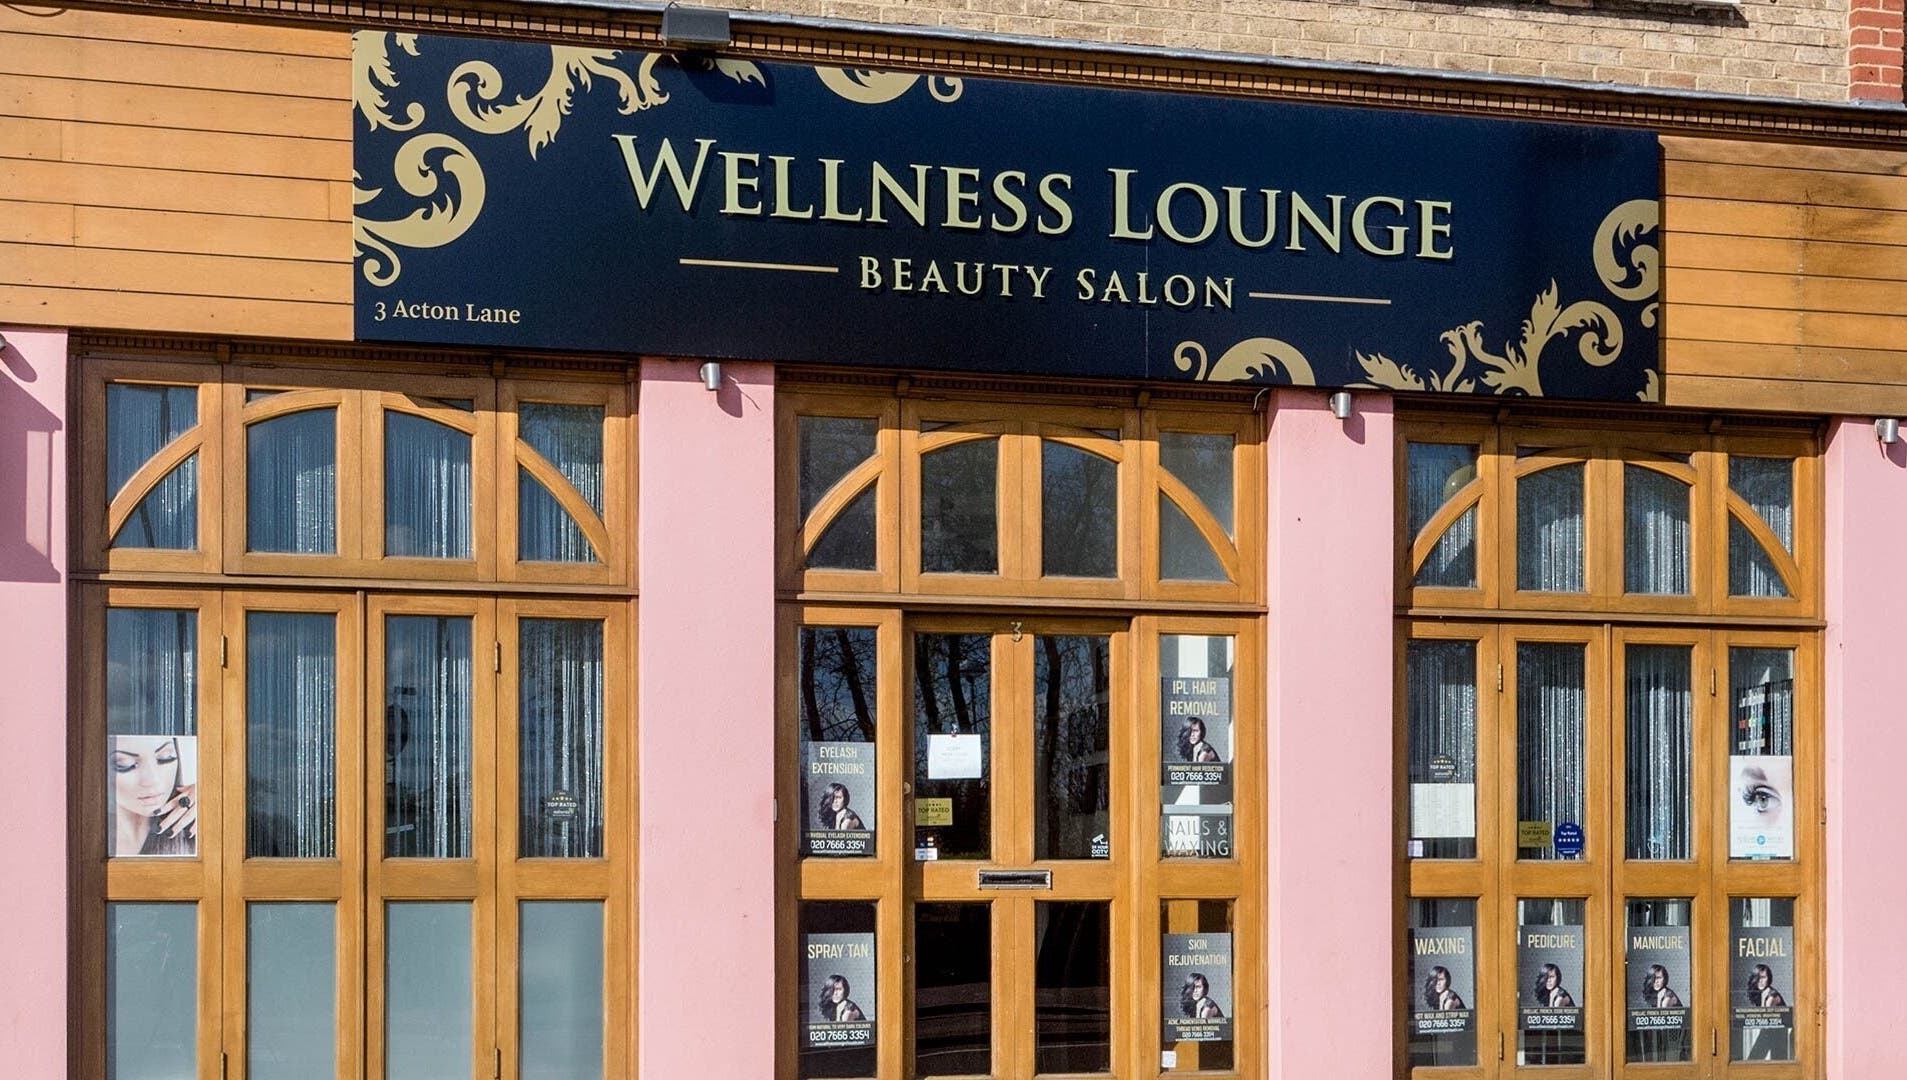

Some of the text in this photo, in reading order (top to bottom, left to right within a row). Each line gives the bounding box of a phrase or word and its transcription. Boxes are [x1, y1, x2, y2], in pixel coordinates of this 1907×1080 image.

[612, 134, 1455, 261] WELLNESS LOUNGE
[859, 256, 1234, 309] BEAUTY SALON
[374, 301, 521, 325] 3 Acton Lane
[1010, 621, 1021, 641] 3
[1172, 680, 1217, 695] IPL HAIR
[1170, 701, 1219, 716] REMOVAL
[819, 746, 857, 759] EYELASH
[812, 762, 864, 774] EXTENSIONS
[1170, 771, 1222, 781] 020 7666 3354
[1165, 820, 1228, 836] NAILS &
[811, 840, 865, 850] 020 7666 3354
[1164, 840, 1229, 856] WAXING
[1188, 939, 1207, 950] SKIN
[1415, 937, 1465, 955] WAXING
[1528, 934, 1576, 949] PEDICURE
[1633, 935, 1683, 950] MANICURE
[1739, 937, 1787, 957] FACIAL
[808, 943, 868, 959] SPRAY TAN
[1169, 954, 1227, 966] REJUVENATION
[1419, 1019, 1465, 1028] 020 7666 3354
[1527, 1015, 1575, 1024] 020 7666 3354
[1636, 1016, 1682, 1025] 020 7666 3354
[810, 1030, 870, 1041] 020 7666 3354
